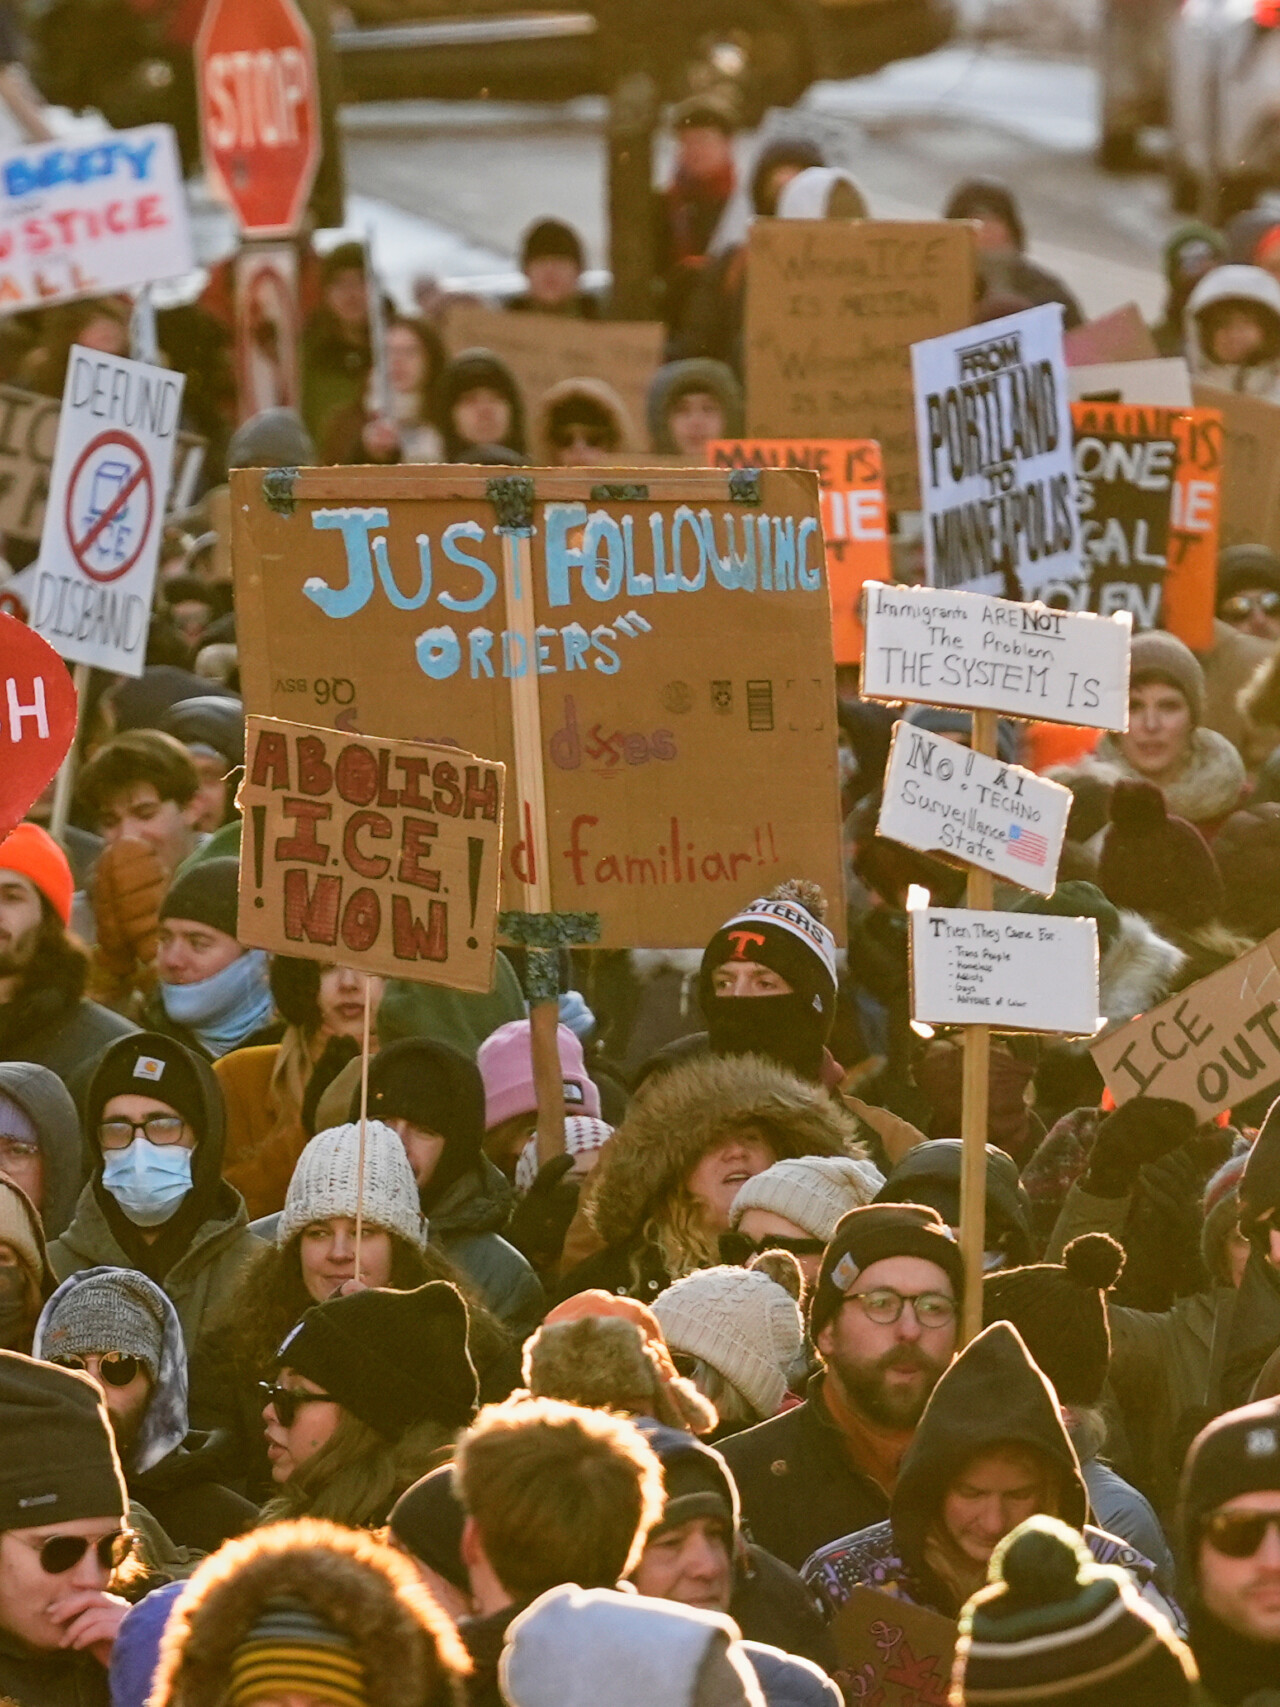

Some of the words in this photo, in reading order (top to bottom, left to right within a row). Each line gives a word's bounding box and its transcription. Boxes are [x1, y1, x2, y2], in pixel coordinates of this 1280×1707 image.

[206, 45, 309, 150] STOP
[960, 335, 1019, 381] FROM
[72, 357, 179, 437] DEFUND
[926, 358, 1058, 488] PORTLAND
[845, 446, 880, 483] IS
[988, 463, 1016, 496] TO
[302, 507, 537, 619] JUST
[544, 502, 820, 608] FOLLOWING
[33, 571, 146, 652] DISBAND
[876, 590, 968, 624] Immigrants
[982, 605, 1018, 628] ARE
[1020, 608, 1067, 635] NOT
[928, 626, 963, 649] The
[983, 631, 1055, 661] Problem
[879, 647, 935, 687] THE
[939, 653, 1050, 698] SYSTEM
[1066, 672, 1101, 708] IS
[250, 730, 500, 824] ABOLISH
[976, 784, 1042, 823] TECHNO
[993, 767, 1024, 797] AI
[901, 779, 1011, 843] Surveillance
[938, 823, 996, 862] State
[275, 796, 450, 894] I.C.E.
[283, 868, 449, 963] NOW
[972, 923, 1000, 943] They
[1112, 998, 1215, 1098] ICE
[1196, 1001, 1280, 1104] OUT
